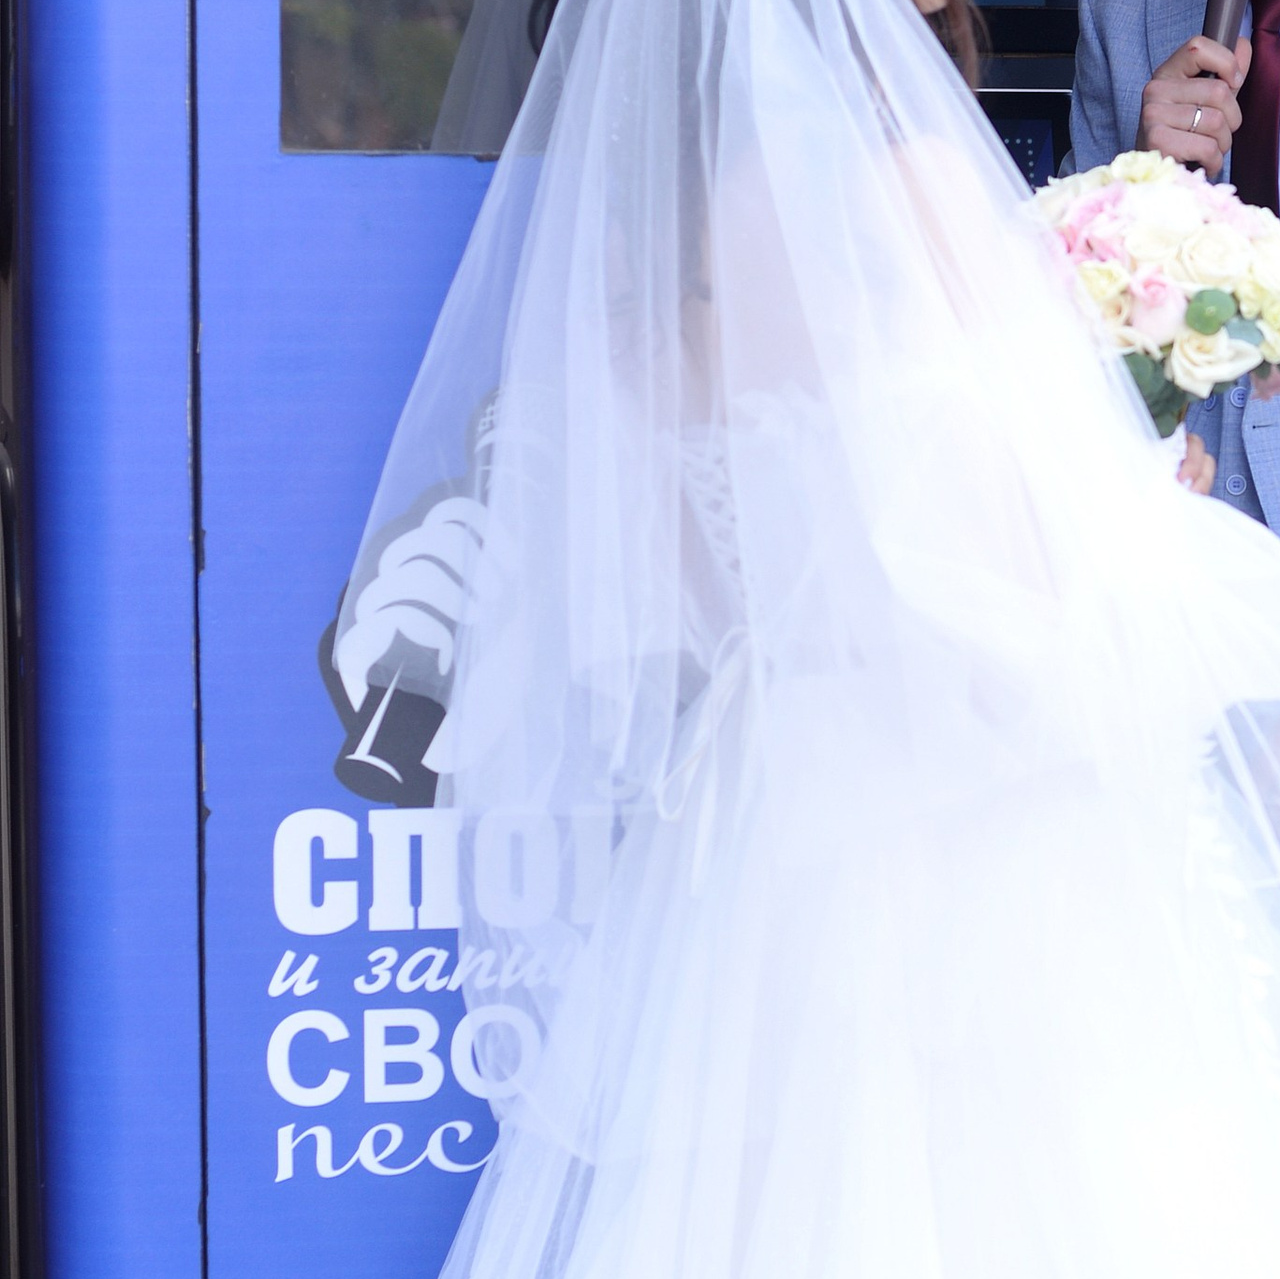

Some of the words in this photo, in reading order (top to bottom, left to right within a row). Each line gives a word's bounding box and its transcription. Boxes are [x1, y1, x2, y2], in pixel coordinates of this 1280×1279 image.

[267, 949, 320, 998] и
[353, 945, 573, 995] запи
[266, 1003, 546, 1108] СВО
[274, 1119, 499, 1183] пес
